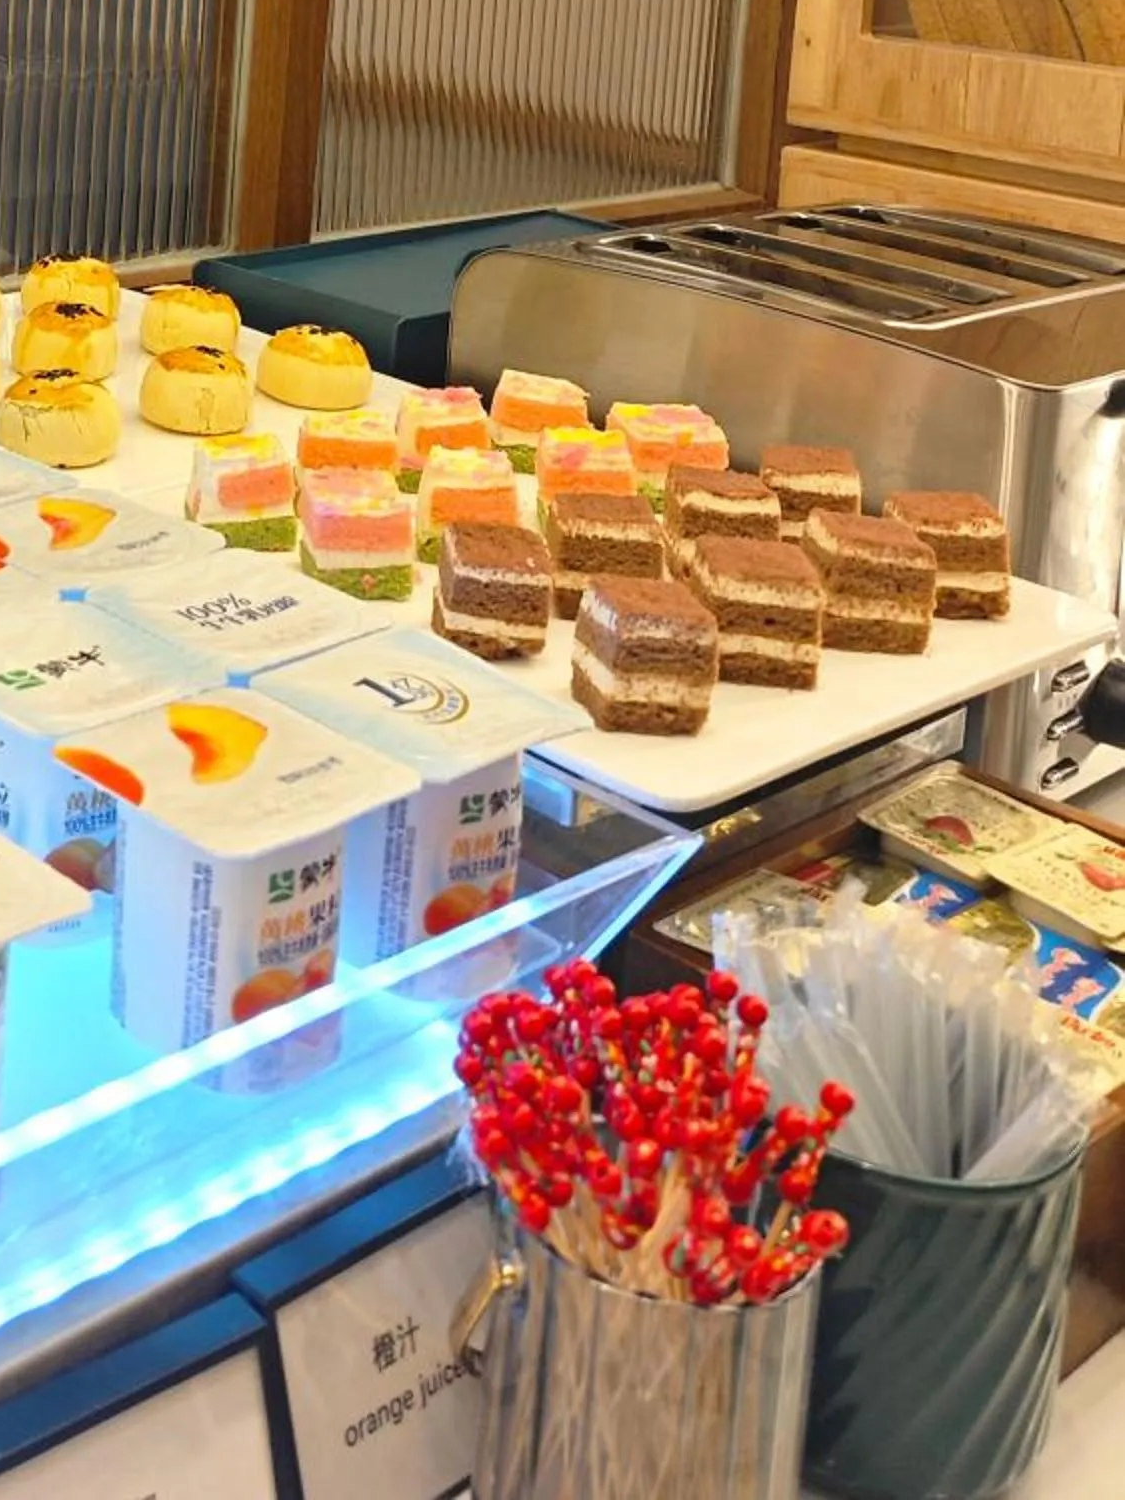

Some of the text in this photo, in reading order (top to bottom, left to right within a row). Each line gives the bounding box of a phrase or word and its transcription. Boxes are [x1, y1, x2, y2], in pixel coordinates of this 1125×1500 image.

[174, 591, 253, 621] 100%
[372, 1315, 420, 1373] 橙汁
[344, 1363, 467, 1448] orange juice
